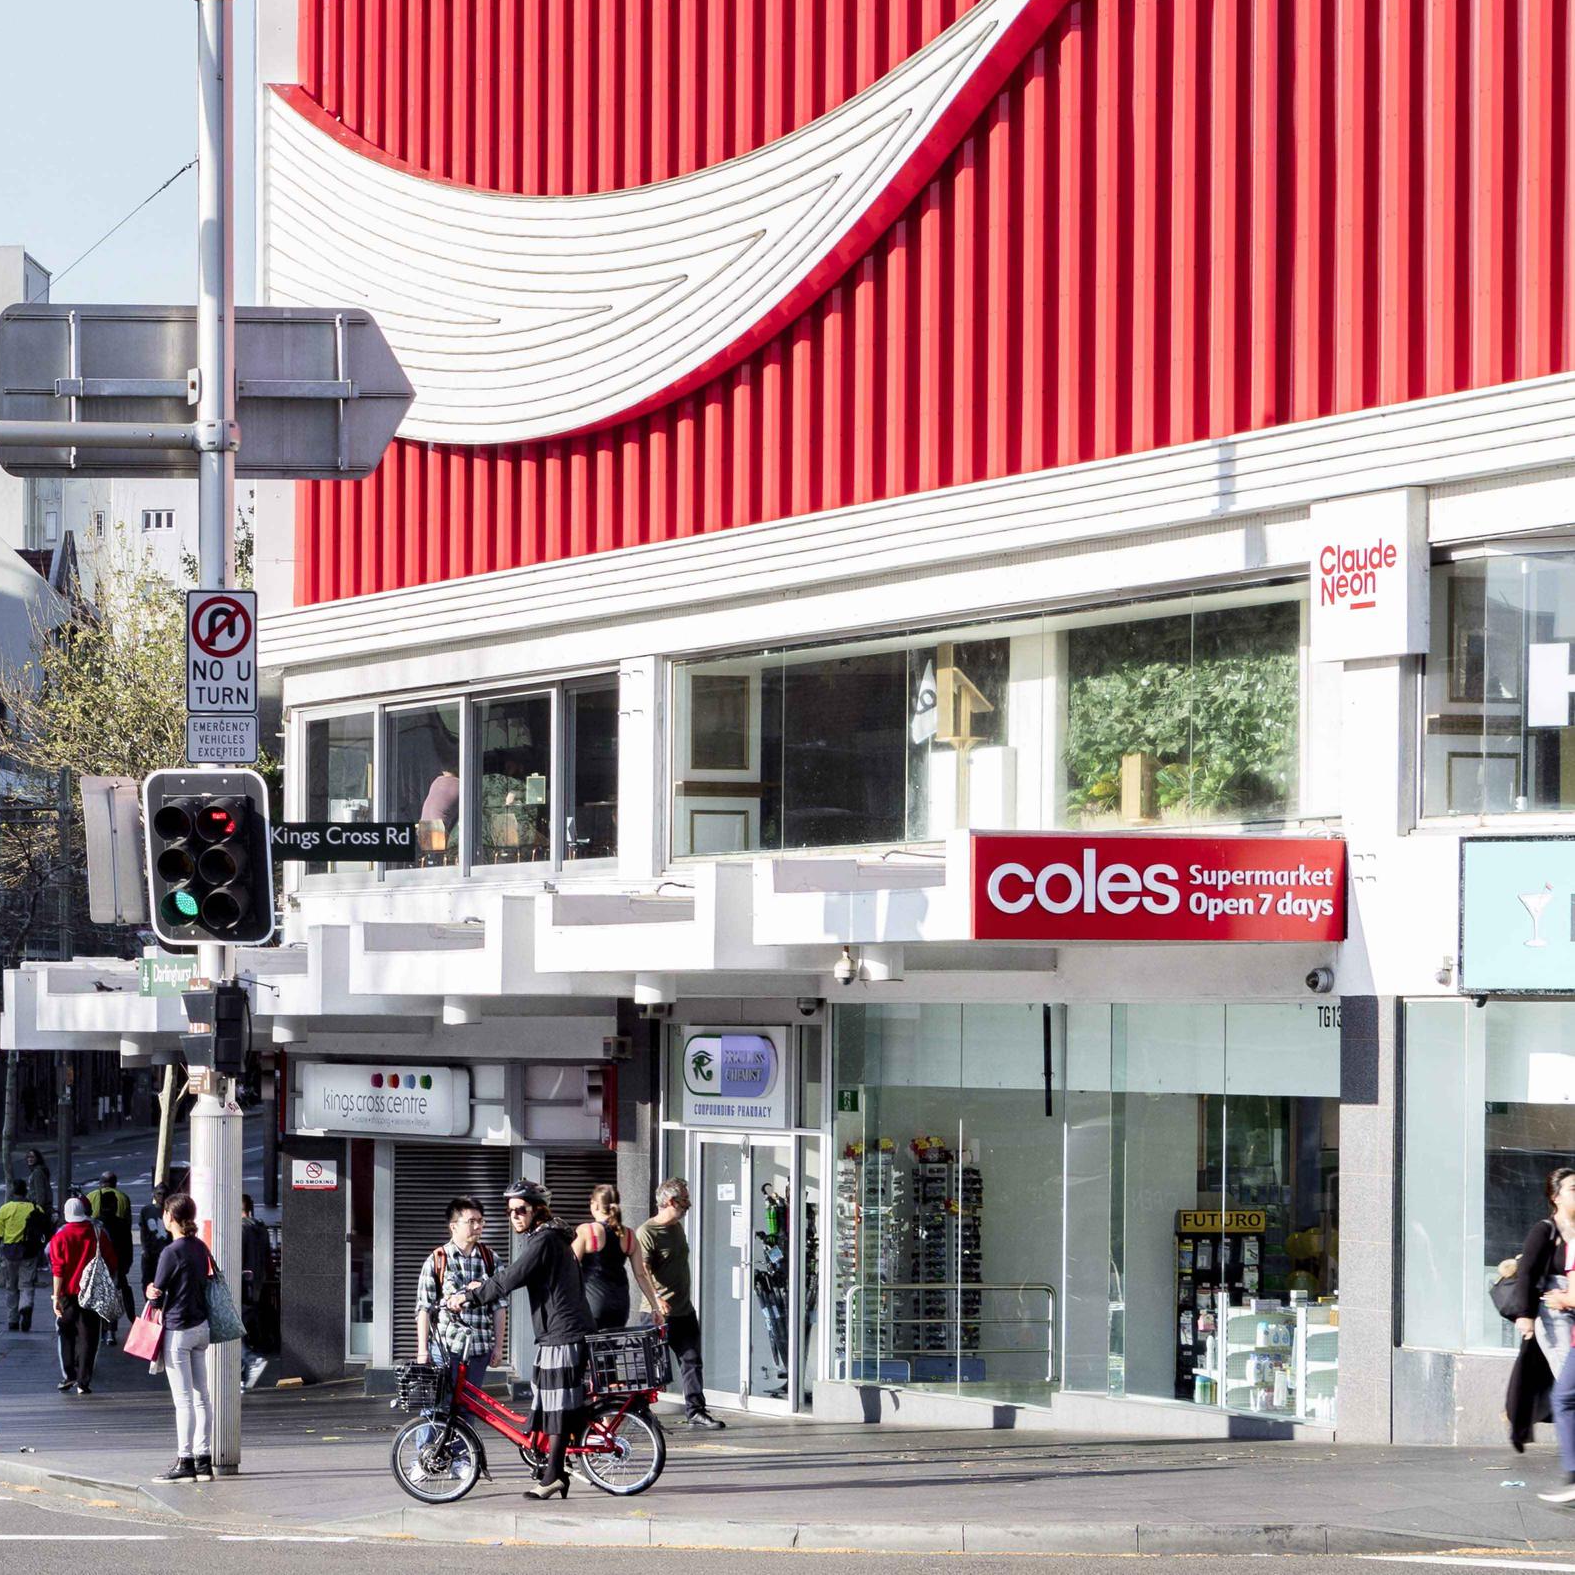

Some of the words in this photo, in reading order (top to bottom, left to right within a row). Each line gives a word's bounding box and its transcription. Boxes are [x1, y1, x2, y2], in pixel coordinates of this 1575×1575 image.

[1320, 537, 1397, 576] Claude
[1321, 571, 1376, 606] Neon
[192, 660, 224, 681] NO
[237, 660, 251, 681] U
[195, 686, 249, 705] TURN
[193, 721, 250, 732] EMERGENCY
[199, 734, 245, 744] VEHICLES
[198, 747, 245, 757] EXCEPTED
[270, 826, 320, 849] Kings
[326, 826, 380, 845] Cross
[386, 827, 410, 845] Rd
[987, 848, 1181, 915] coles
[1189, 864, 1334, 891] Supermarket
[1189, 892, 1255, 922] Open
[1258, 893, 1273, 916] 7
[1277, 891, 1334, 923] days
[153, 963, 191, 988] Darlinghurst
[725, 1068, 763, 1082] CHEMIST
[323, 1087, 355, 1118] kings
[356, 1094, 385, 1113] cross
[387, 1095, 427, 1115] centre
[694, 1103, 735, 1117] COMPOUNDING
[738, 1104, 771, 1118] PHARMACY
[1182, 1213, 1261, 1227] FUTURO
